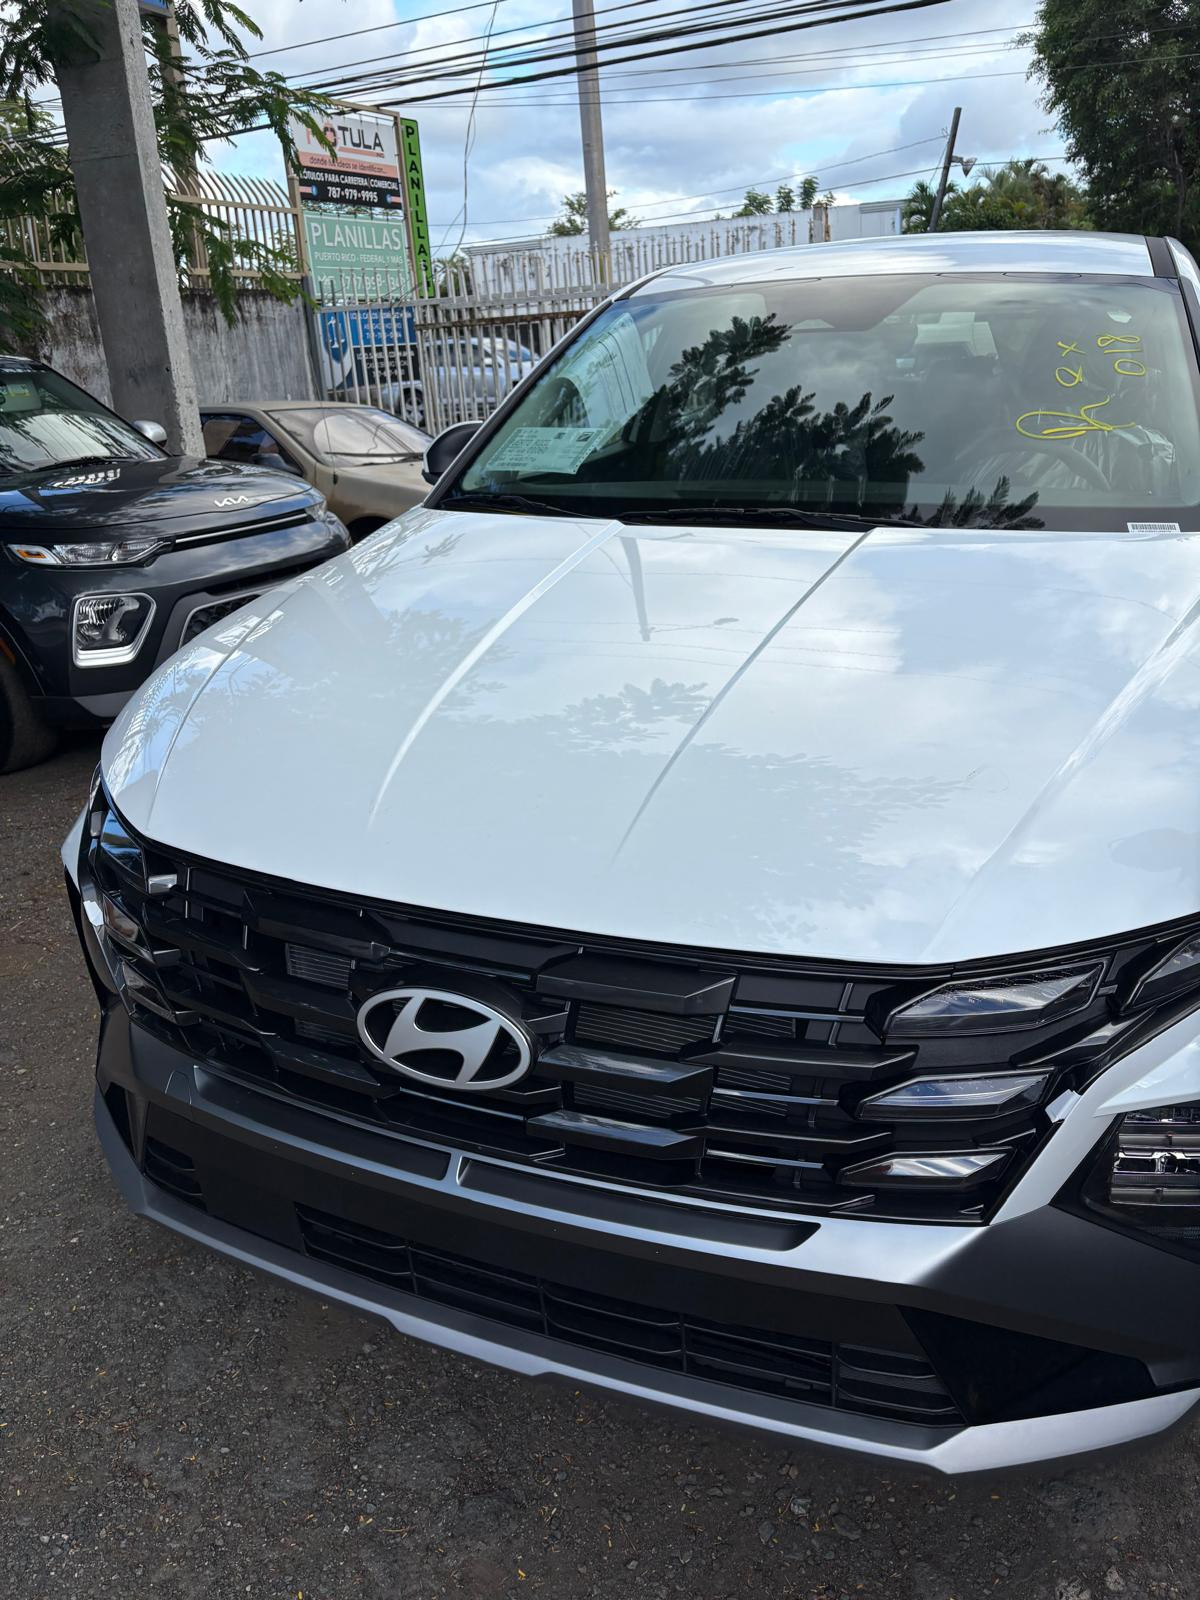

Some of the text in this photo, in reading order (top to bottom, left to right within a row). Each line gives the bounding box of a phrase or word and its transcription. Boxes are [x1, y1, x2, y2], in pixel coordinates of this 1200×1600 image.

[324, 172, 339, 183] PARA
[340, 175, 368, 186] CARRETERA
[370, 178, 398, 190] COMERCIAL
[405, 124, 428, 272] PLANILLAS
[310, 221, 402, 251] PLANILLAS
[313, 251, 340, 262] PUERTO
[341, 253, 356, 263] RICO
[360, 254, 385, 264] FEDERAL
